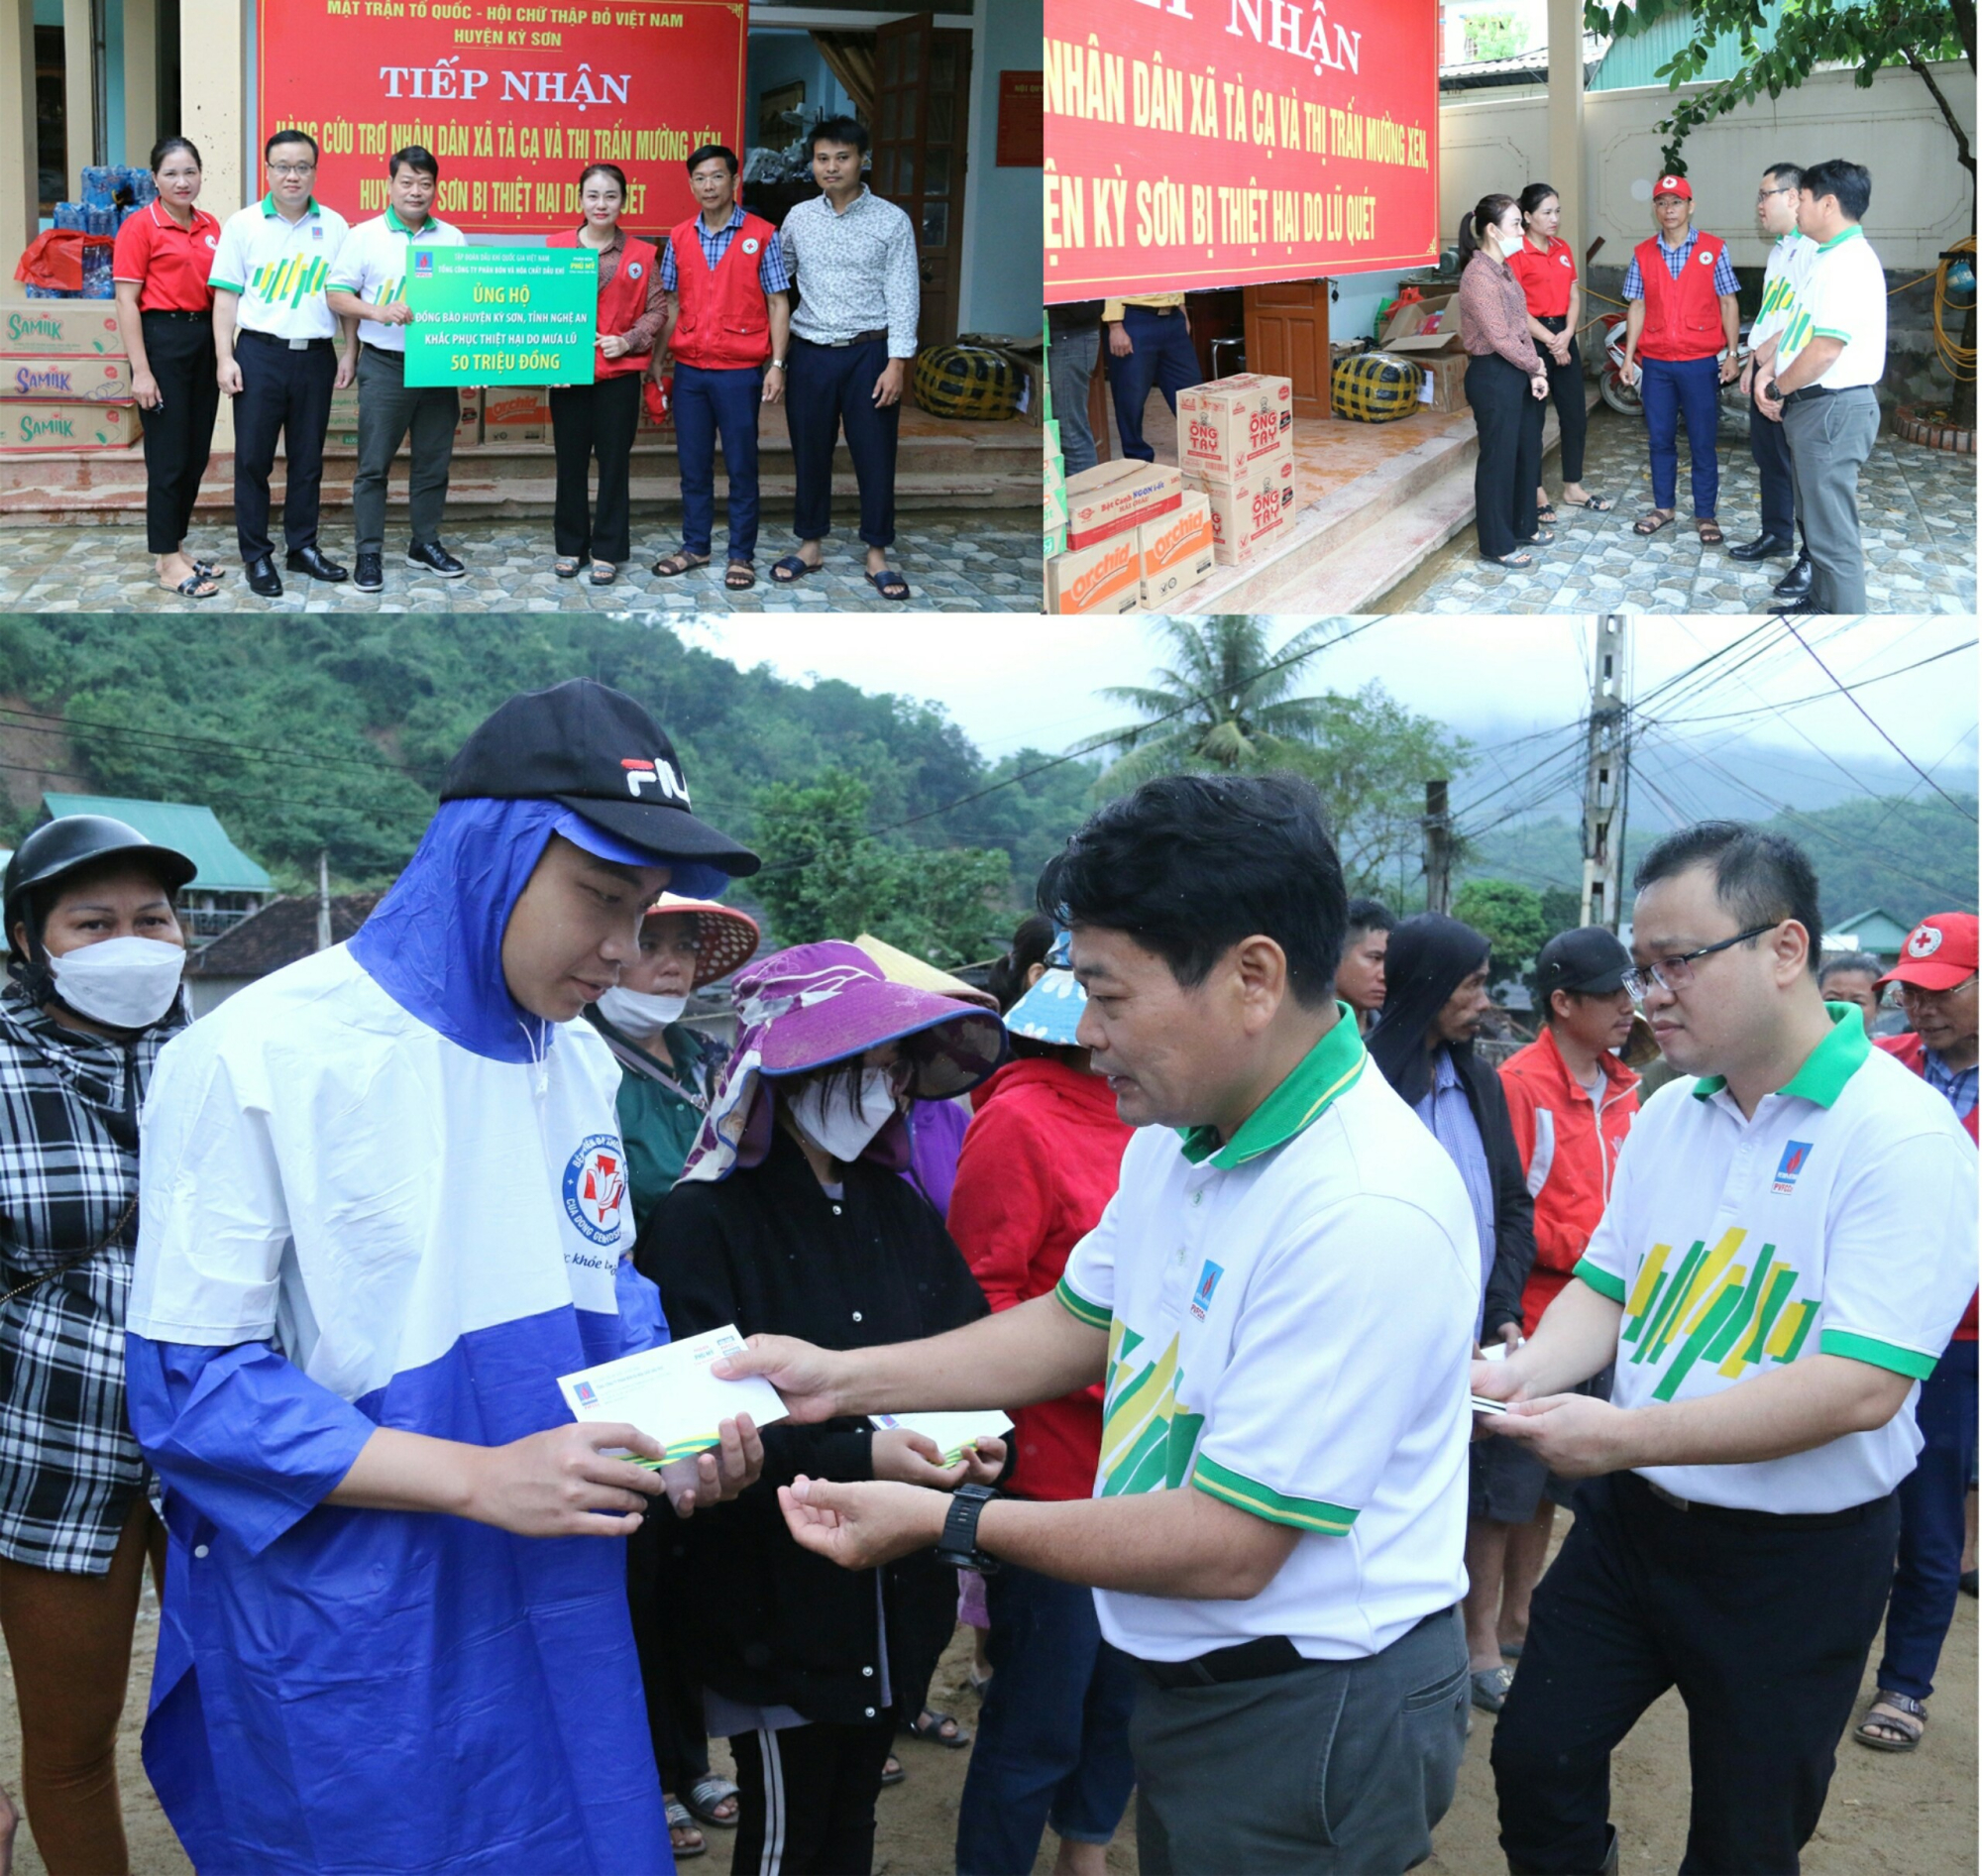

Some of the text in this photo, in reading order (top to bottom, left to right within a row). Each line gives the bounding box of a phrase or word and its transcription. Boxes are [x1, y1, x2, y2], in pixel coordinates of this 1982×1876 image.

[365, 0, 404, 20] TRẬN
[432, 0, 472, 20] QUỐC
[487, 4, 511, 24] HỘI
[516, 6, 548, 22] CHỮ
[551, 7, 588, 27] THẬP
[592, 7, 611, 25] ĐỎ
[615, 10, 646, 29] VIỆT
[650, 14, 684, 28] NAM
[454, 28, 562, 47] HUYỆN KỲ SƠN
[1226, 0, 1362, 76] NHẬN
[379, 55, 631, 112] TIẾP NHẬN
[1044, 33, 1429, 174] NHÂN DÂN XÃ TÀ CẠ VÀ THỊ TRẤN MƯỜNG XÉN,
[323, 116, 354, 155] CỨU
[358, 119, 387, 162] TRỢ
[390, 118, 433, 151] NHÂN
[438, 119, 469, 157] DÂN
[473, 120, 494, 157] XÃ
[497, 121, 515, 158] TÀ
[520, 127, 539, 166] CẠ
[544, 122, 563, 159] VÀ
[567, 128, 590, 166] THỊ
[595, 119, 631, 161] TRẤN
[636, 124, 689, 161] MƯỜNG
[360, 178, 388, 211] HUY
[437, 178, 469, 213] SƠN
[475, 180, 488, 219] BỊ
[493, 175, 532, 220] THIỆT
[536, 182, 561, 220] HẠI
[1093, 164, 1128, 248] KỲ
[1136, 174, 1185, 247] SƠN
[1192, 183, 1214, 258] BỊ
[1218, 176, 1267, 257] THIỆT
[1272, 189, 1300, 255] HẠI
[1303, 191, 1323, 243] DO
[1326, 184, 1343, 241] LŨ
[1346, 186, 1376, 246] QUÉT
[473, 282, 530, 307] ỦNG HỘ
[415, 311, 587, 325] ĐỒNG BÀO HUYỆN KỲ SƠN, TỈNH NGHỆ AN
[425, 332, 577, 349] KHẮC PHỤC THIỆT HẠI DO MƯA LŨ
[451, 350, 560, 375] 50 TRIỆU ĐỒNG
[1189, 420, 1218, 439] ÔNG
[1250, 411, 1276, 433] ÔNG
[1253, 490, 1279, 513] ÔNG
[620, 758, 691, 808] FIL
[566, 1198, 577, 1218] CUA
[574, 1215, 593, 1237] DONG
[572, 1253, 603, 1269] khỏe
